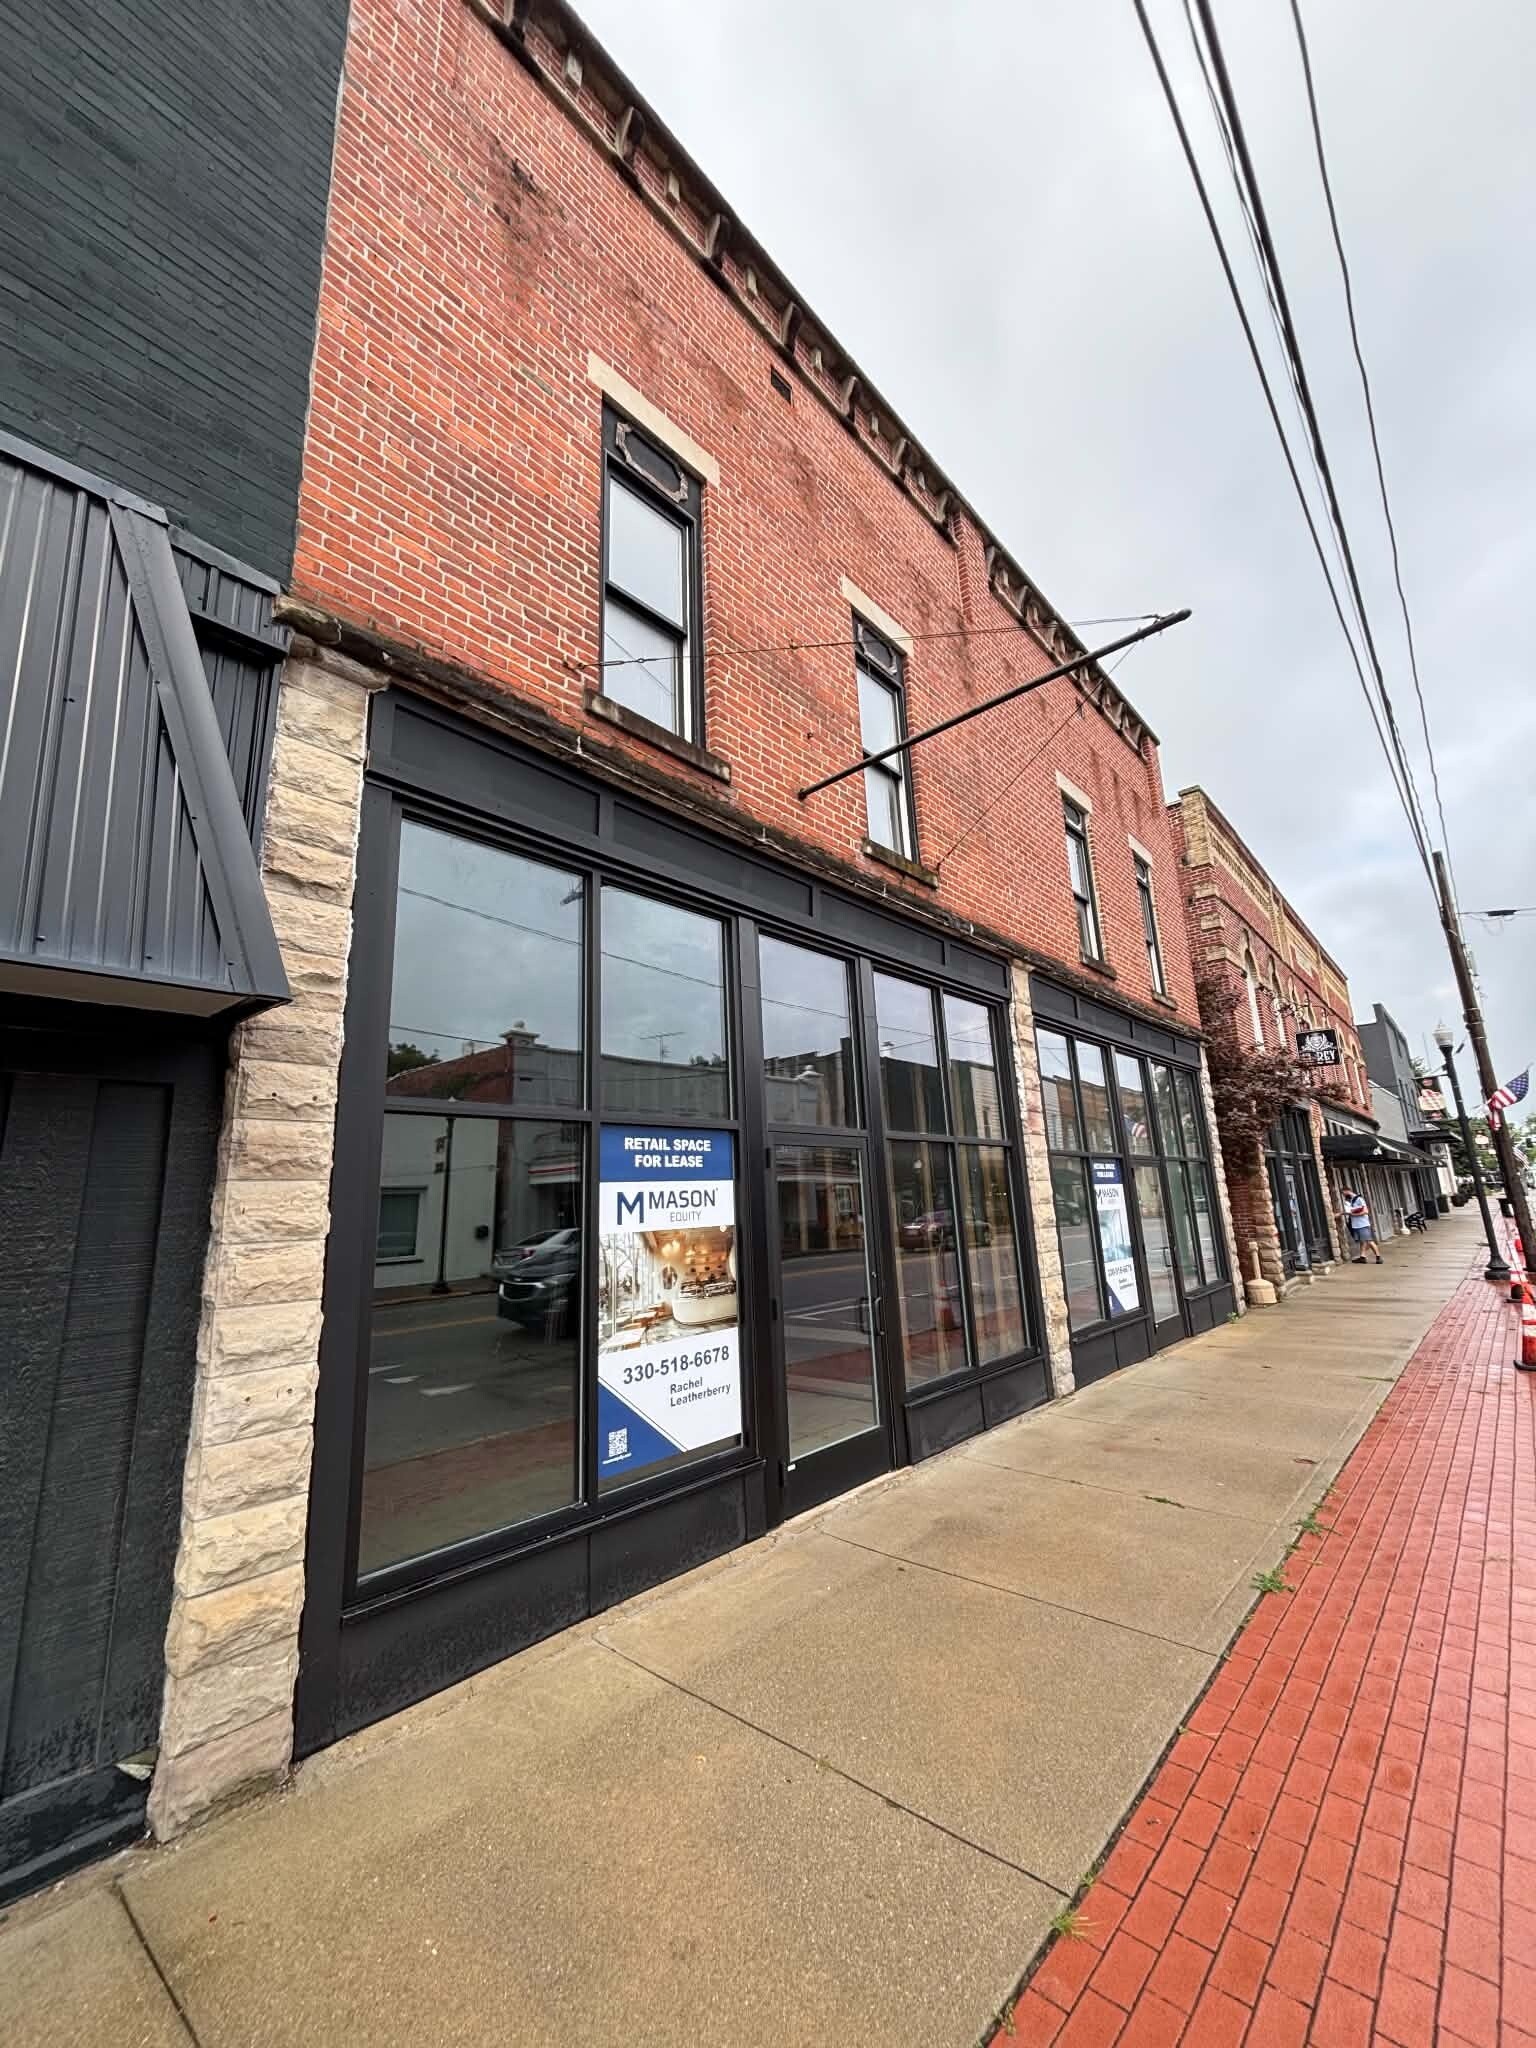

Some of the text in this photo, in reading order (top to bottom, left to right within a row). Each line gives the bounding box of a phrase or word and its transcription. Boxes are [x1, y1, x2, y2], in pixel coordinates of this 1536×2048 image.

[624, 1137, 712, 1152] RETAIL SPACE
[634, 1155, 704, 1168] FOR LEASE
[617, 1189, 715, 1225] M MASON
[670, 1211, 701, 1222] EQUITY
[623, 1346, 729, 1384] 330-518-6678
[670, 1376, 703, 1394] Rachel
[670, 1384, 731, 1407] Leatherberry
